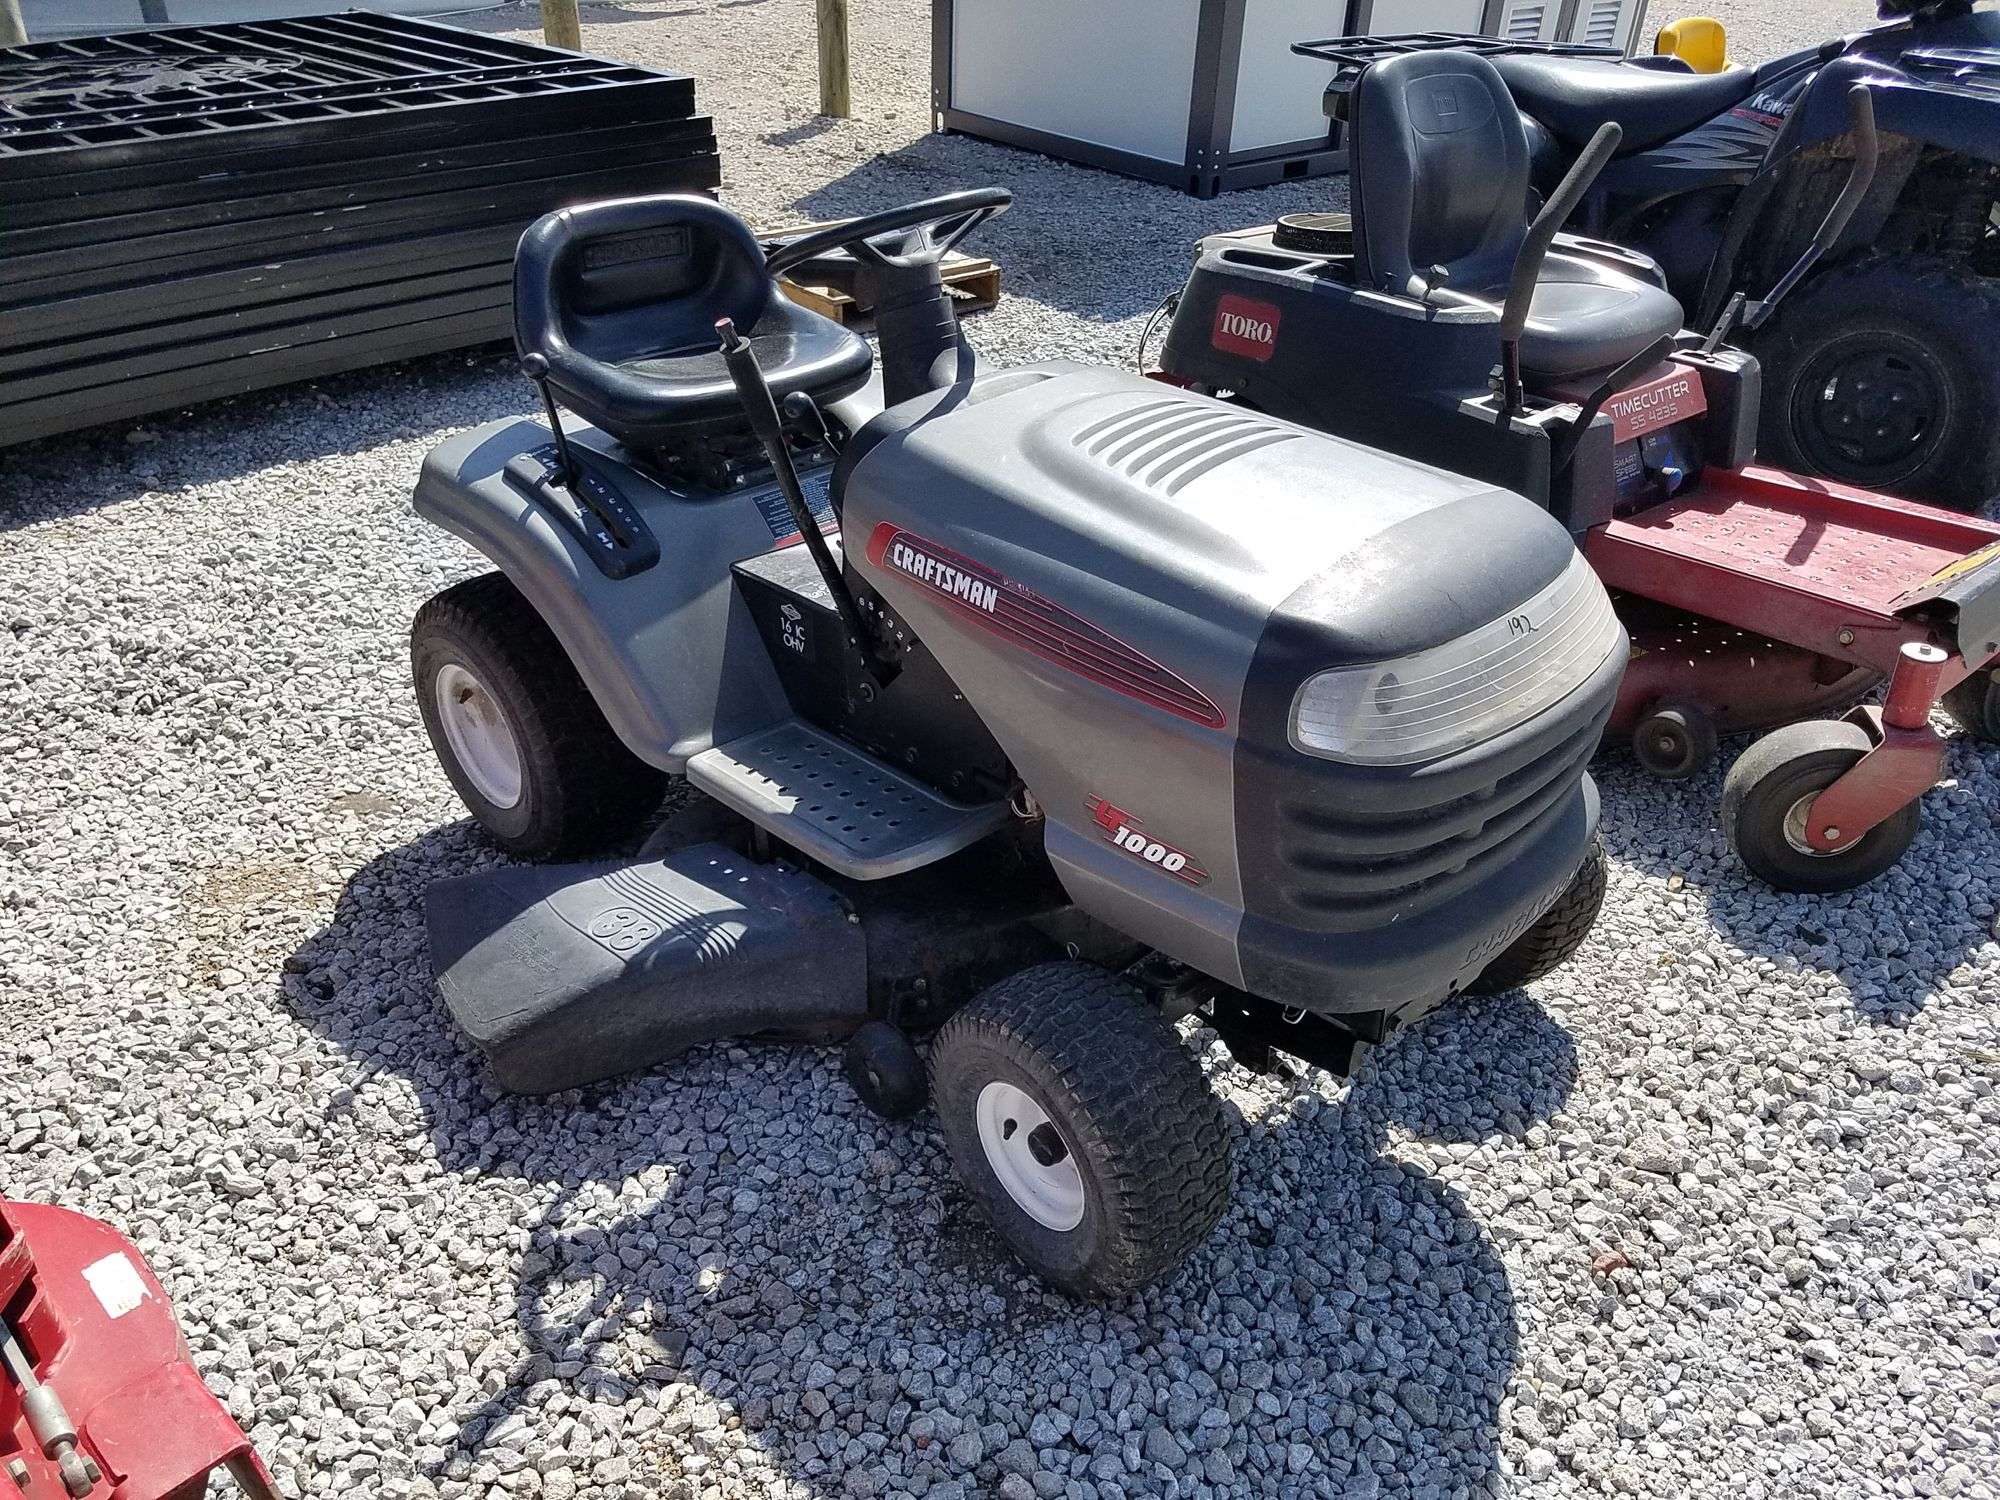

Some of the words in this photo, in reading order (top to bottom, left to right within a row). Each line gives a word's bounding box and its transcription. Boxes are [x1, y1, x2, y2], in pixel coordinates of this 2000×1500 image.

[1220, 312, 1272, 343] TORO
[1611, 380, 1690, 418] TIMECUTTER
[1630, 414, 1646, 431] SS
[1649, 402, 1678, 421] 4235
[893, 543, 999, 614] CRAFTSMAN
[780, 617, 792, 634] 16
[1507, 614, 1539, 636] 192
[783, 633, 804, 653] OHV
[1113, 825, 1186, 872] 1000
[591, 911, 658, 951] 38
